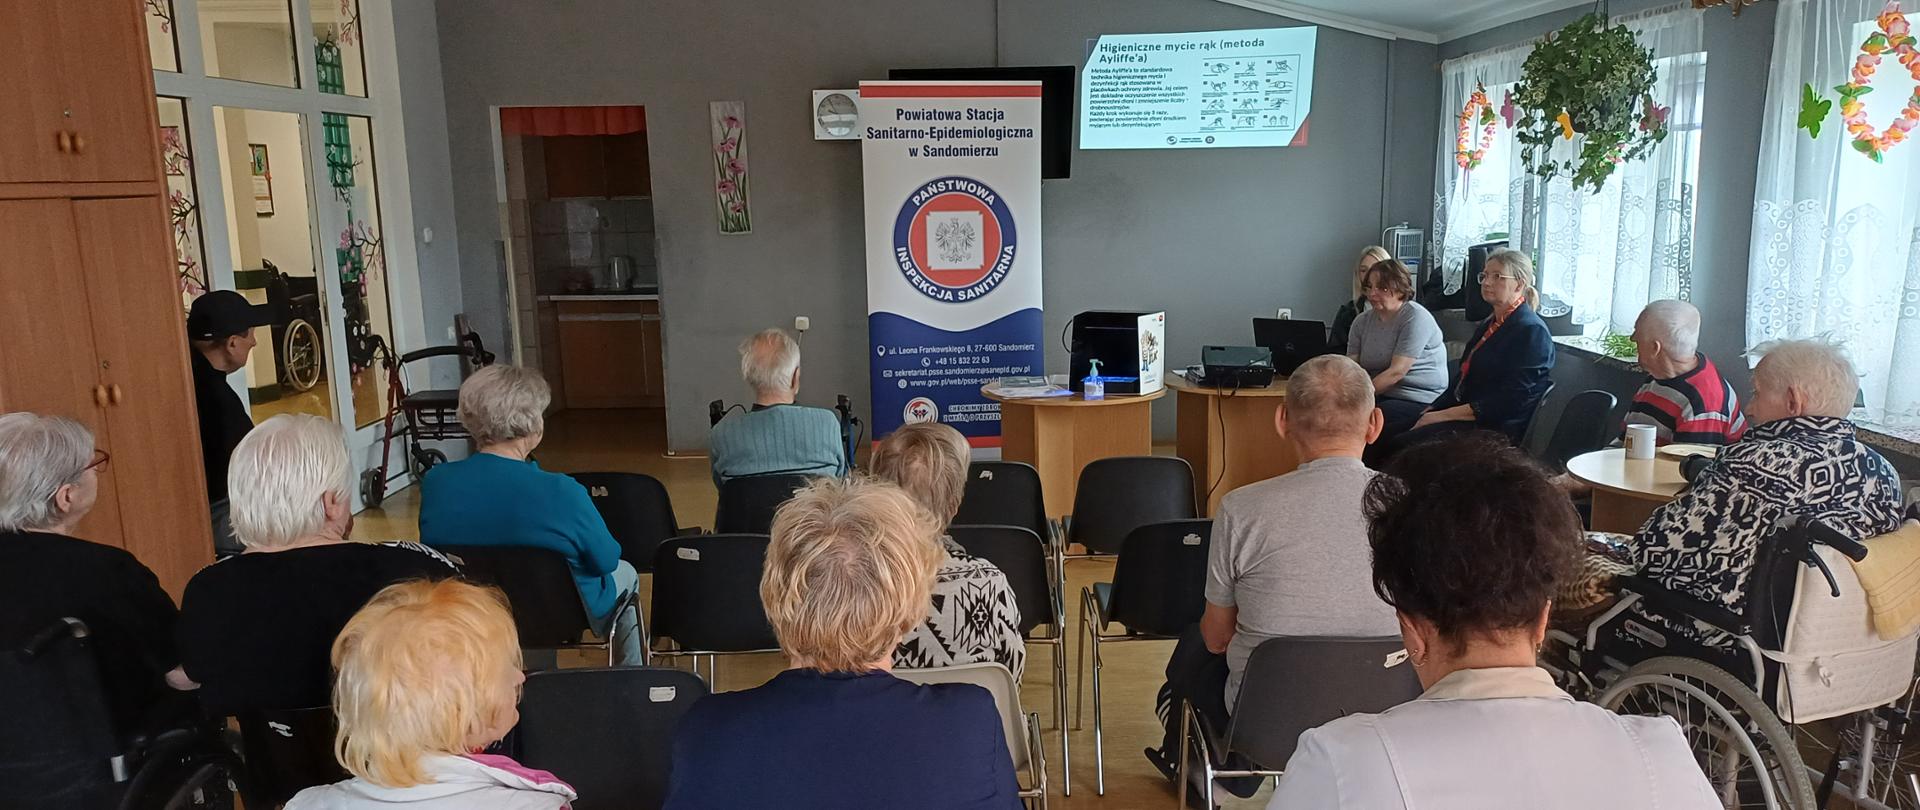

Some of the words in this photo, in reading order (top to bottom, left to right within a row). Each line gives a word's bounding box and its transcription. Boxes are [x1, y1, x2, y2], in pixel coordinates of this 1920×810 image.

[1100, 43, 1161, 53] Higieniczne
[1165, 41, 1196, 52] mycie
[1199, 40, 1216, 50] rąk
[1220, 38, 1265, 49] (metoda
[1099, 54, 1148, 64] Ayliffe'a)
[896, 108, 962, 121] Powiatowa
[966, 108, 1005, 123] Stacja
[866, 126, 1034, 141] Sanitarno-Epidemiologiczna
[909, 147, 918, 157] w
[923, 144, 998, 157] Sandomierzu
[912, 180, 996, 206] PAŃSTWOWA
[896, 247, 954, 300] INSPEKCJA
[958, 245, 1014, 300] SANITARNA
[974, 344, 998, 352] 27-600
[998, 344, 1035, 352] Sandomierz
[935, 357, 948, 365] +48
[958, 356, 970, 364] 832
[972, 356, 980, 364] 22
